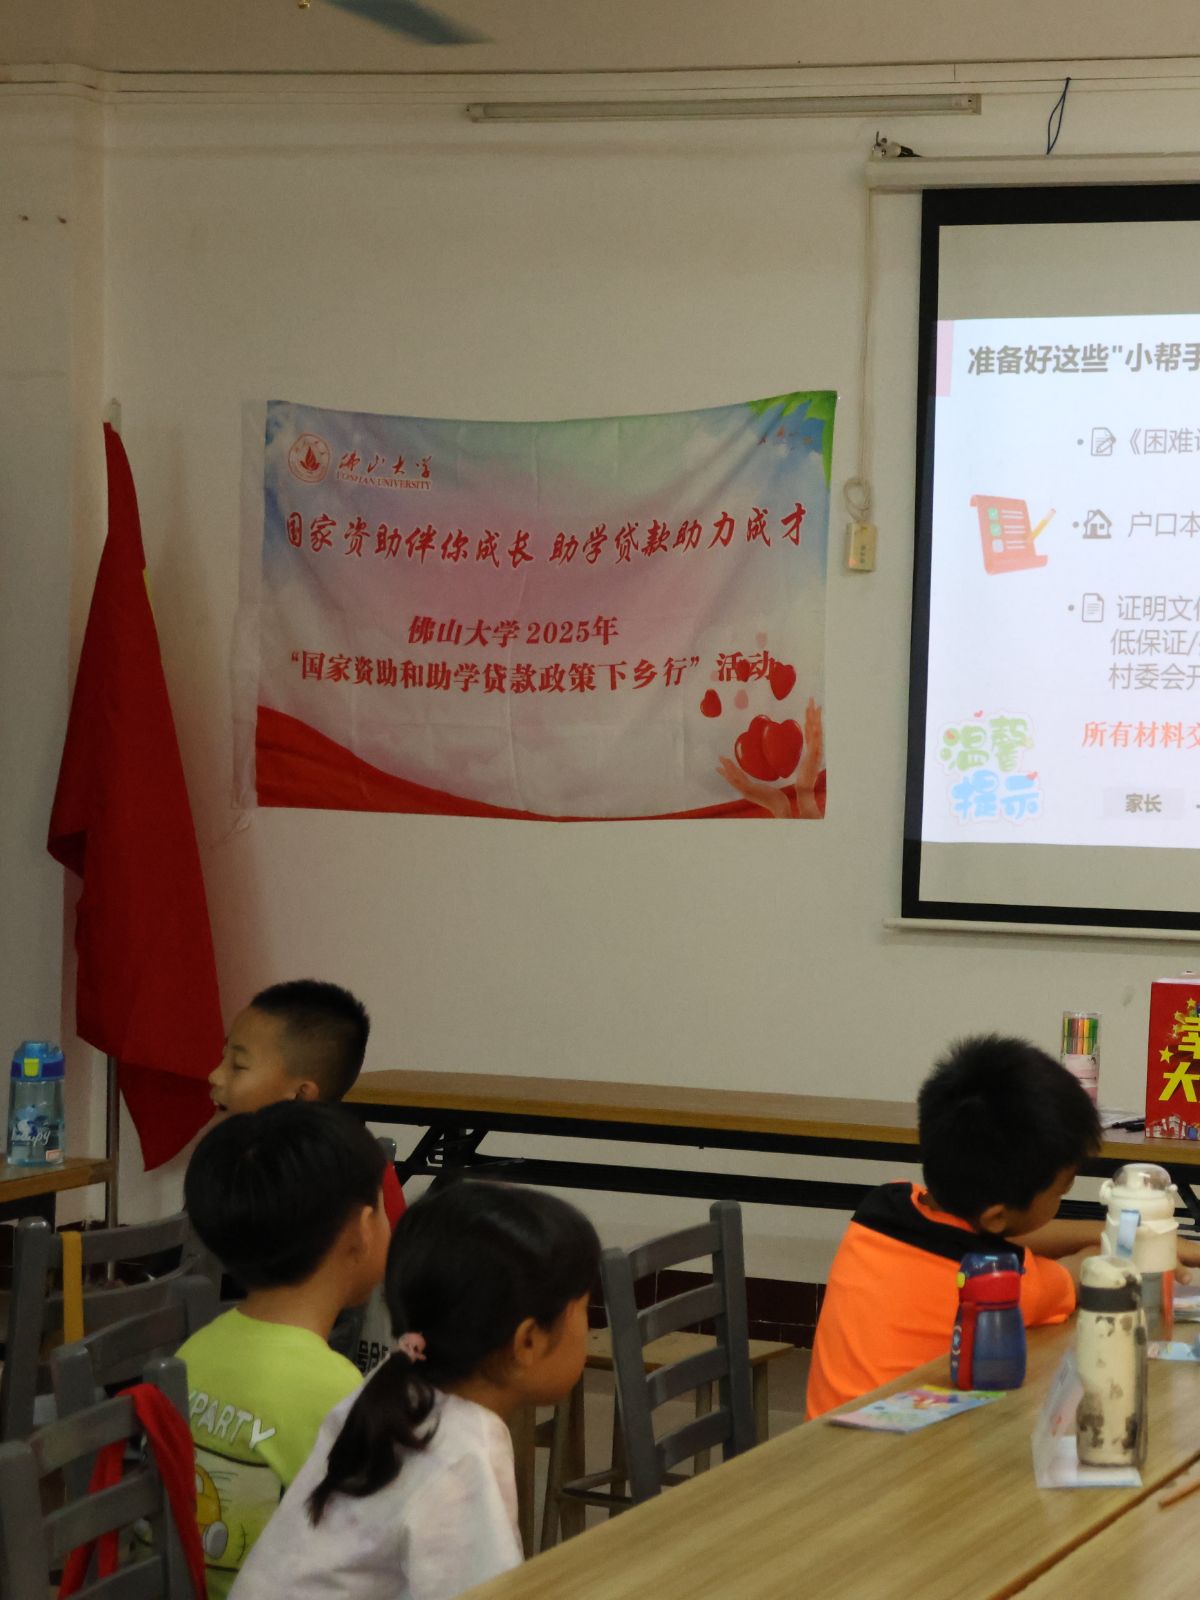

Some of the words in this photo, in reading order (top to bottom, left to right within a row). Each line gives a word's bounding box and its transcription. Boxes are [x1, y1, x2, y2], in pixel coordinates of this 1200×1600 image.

[377, 478, 432, 490] UNIVERSITY
[548, 502, 806, 566] 助学贷款助力成才
[407, 614, 619, 648] 佛山大学2025年
[1125, 793, 1163, 815] 家长
